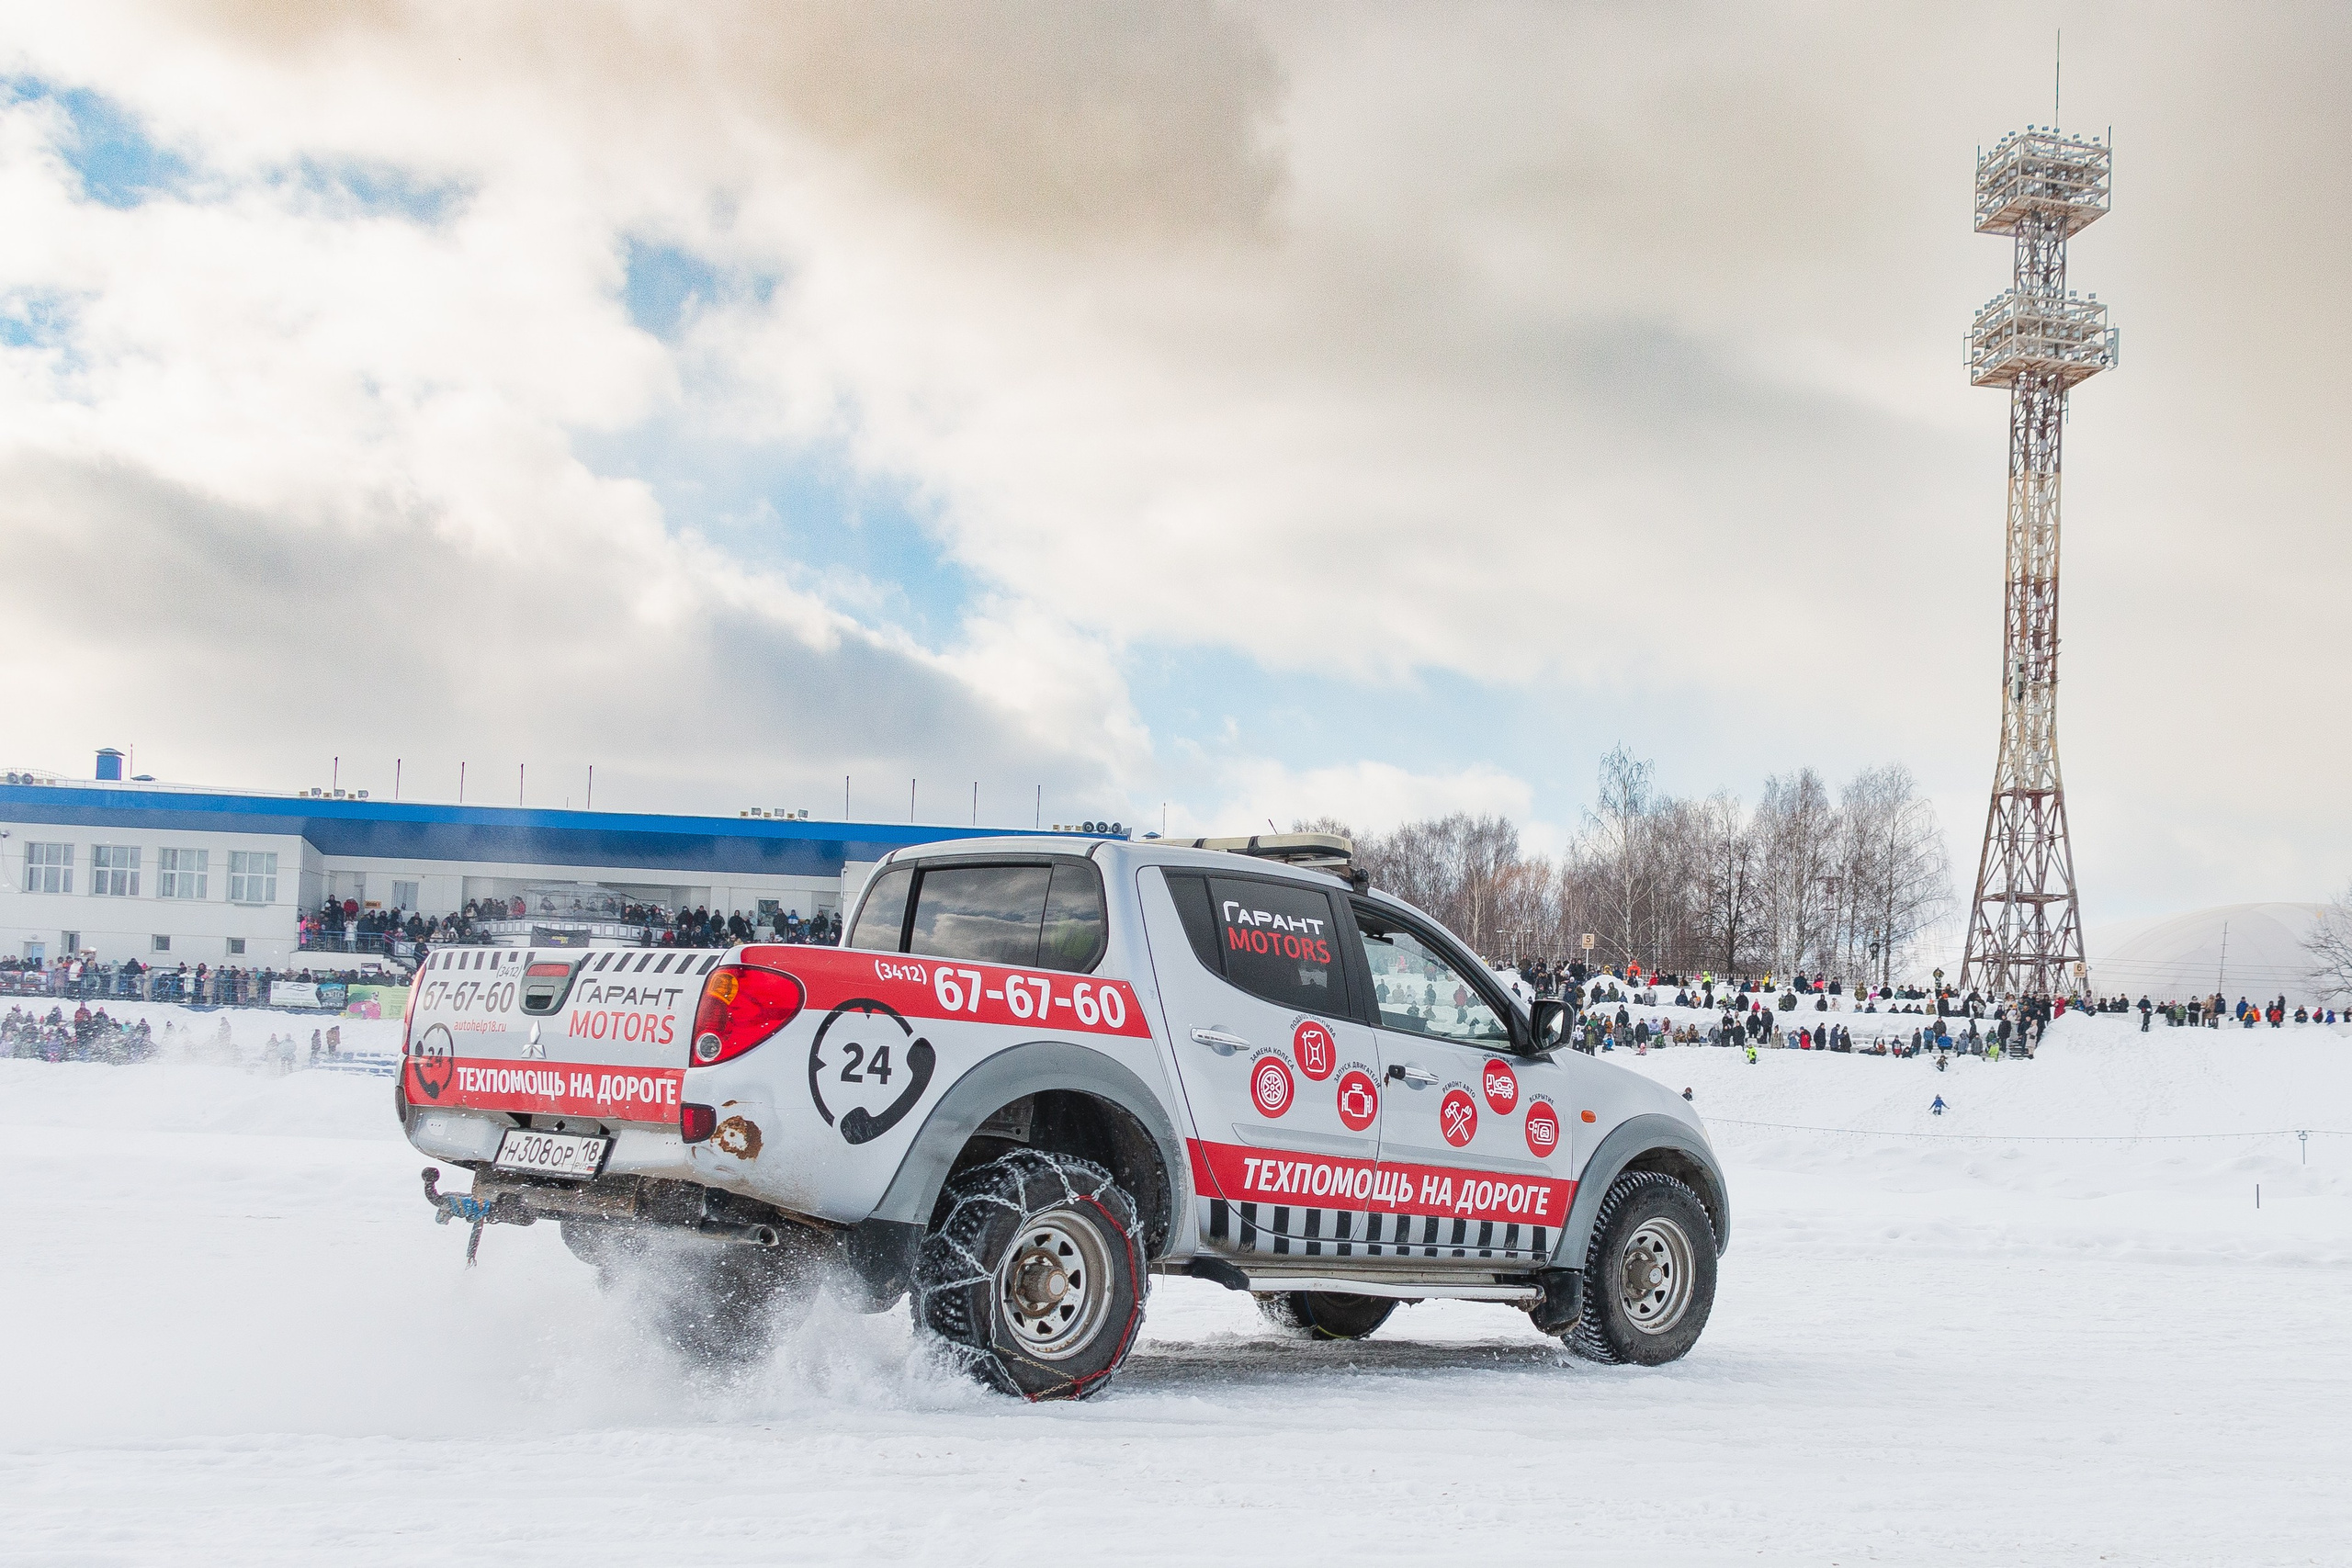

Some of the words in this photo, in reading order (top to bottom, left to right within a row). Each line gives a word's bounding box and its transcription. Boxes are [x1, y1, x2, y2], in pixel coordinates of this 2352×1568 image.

[1223, 900, 1324, 935] ГАРАНТ
[1227, 927, 1331, 964] MOTORS
[1586, 935, 1591, 943] 5
[496, 964, 523, 978] (3412)
[2076, 964, 2083, 972] 6
[423, 981, 515, 1013] 67-67-60
[576, 978, 684, 1009] ГАРАНТ
[875, 960, 927, 985] (3412)
[933, 966, 1126, 1029] 67-67-60
[454, 1019, 507, 1034] autohelp18.ru
[569, 1010, 675, 1044] MOTORS
[425, 1046, 444, 1068] 24
[840, 1043, 892, 1085] 24
[1250, 1046, 1272, 1065] ЗАМЕНА
[1272, 1047, 1295, 1070] КОЛЕСА
[1334, 1061, 1352, 1084] ЗАПУСК
[457, 1066, 566, 1100] ТЕХПОМОЩЬ
[570, 1073, 594, 1099] НА
[597, 1074, 677, 1105] ДОРОГЕ
[1442, 1081, 1463, 1094] РЕМОНТ
[1462, 1081, 1476, 1099] АВТО
[1529, 1093, 1555, 1106] ВСКРЫТИЕ
[582, 1140, 600, 1162] 18
[574, 1162, 588, 1170] RUS
[1243, 1157, 1414, 1208] ТЕХПОМОЩЬ
[1419, 1175, 1453, 1206] НА
[1454, 1179, 1551, 1215] ДОРОГЕ
